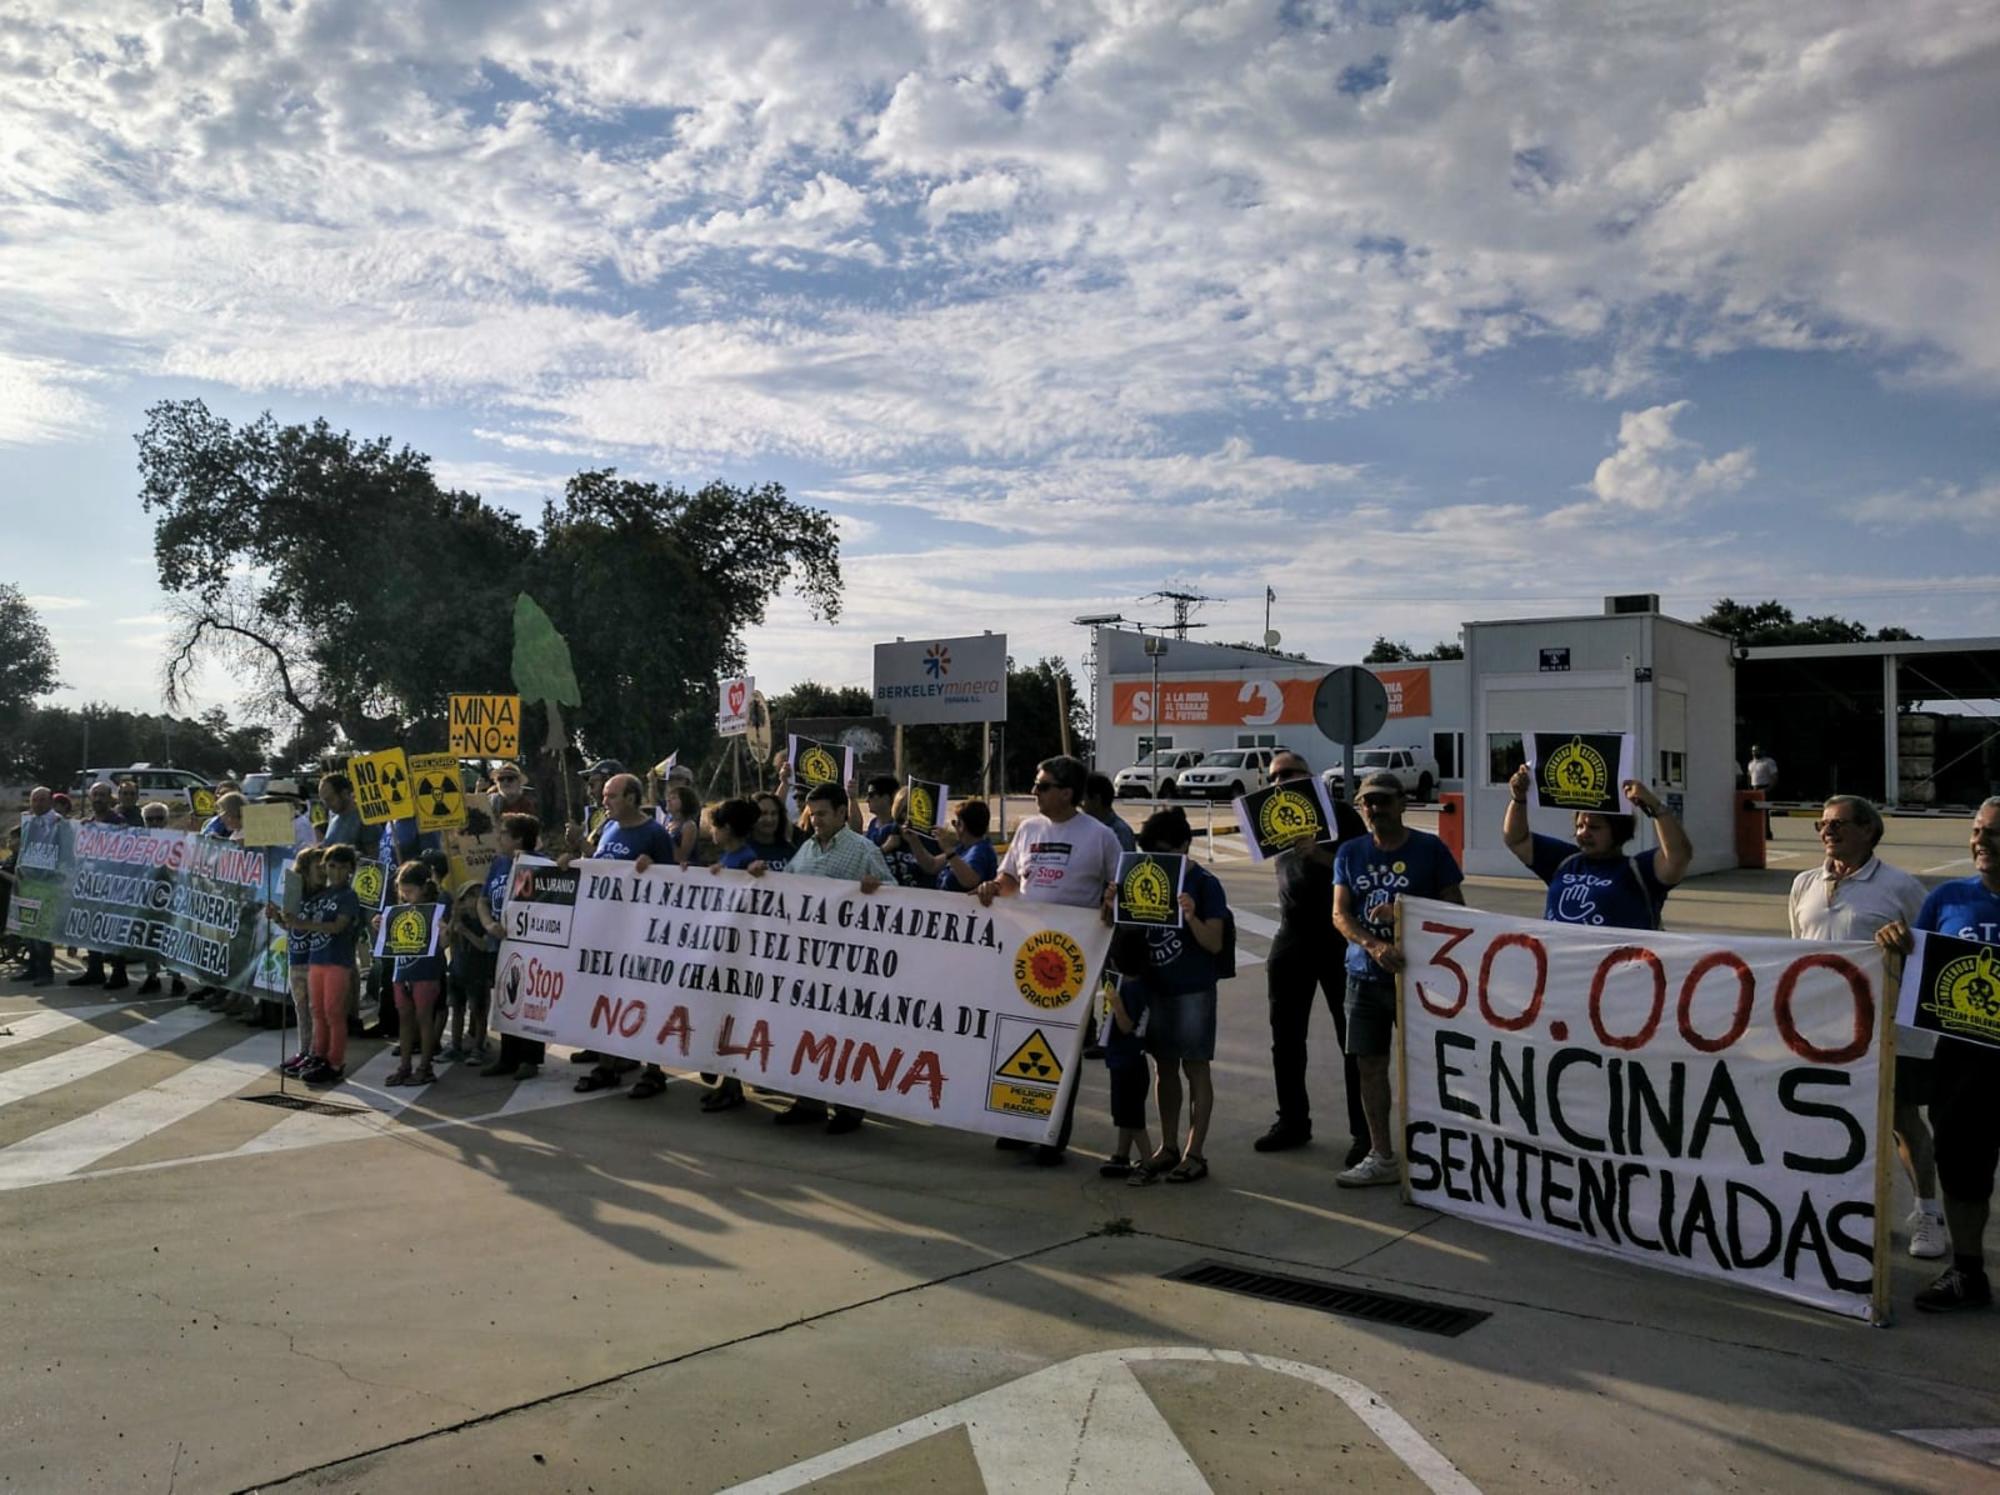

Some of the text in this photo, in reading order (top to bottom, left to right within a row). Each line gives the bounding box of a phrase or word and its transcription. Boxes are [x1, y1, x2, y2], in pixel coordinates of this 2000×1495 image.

[454, 698, 514, 726] MINA
[464, 727, 501, 753] NO
[354, 761, 377, 785] NO
[360, 784, 382, 802] A LA
[361, 800, 391, 819] MINA
[606, 842, 631, 855] TOP
[218, 848, 265, 888] MINA
[1037, 866, 1064, 881] Stop
[1356, 871, 1410, 890] STOP
[1562, 873, 1613, 887] STOP
[74, 870, 172, 910] SALAMANC
[535, 878, 546, 892] AL
[547, 878, 576, 894] URANIO
[516, 904, 562, 937] SÍ A LA VIDA
[587, 875, 1003, 953] POR LA NATURALEZA, LA GANADERÍA,
[65, 907, 90, 938] NO
[177, 929, 230, 977] MINERA
[1958, 922, 2000, 942] ST
[645, 917, 671, 945] LA
[677, 922, 741, 953] SALUD
[796, 936, 899, 978] FUTURO
[526, 957, 564, 1009] Stop
[576, 948, 990, 1039] DEL CAMPO CHARRO Y SALAMANCA DI
[1014, 959, 1072, 1009] NO GRACIAS
[1415, 920, 1876, 1064] 30.000
[590, 994, 949, 1111] NO A LA MINA
[1009, 1085, 1053, 1100] PELIGRO
[1021, 1097, 1036, 1106] DE
[1434, 1030, 1867, 1175] ENCINAS
[1003, 1102, 1052, 1117] RADIACIO
[1405, 1121, 1875, 1295] SENTENCIADAS
